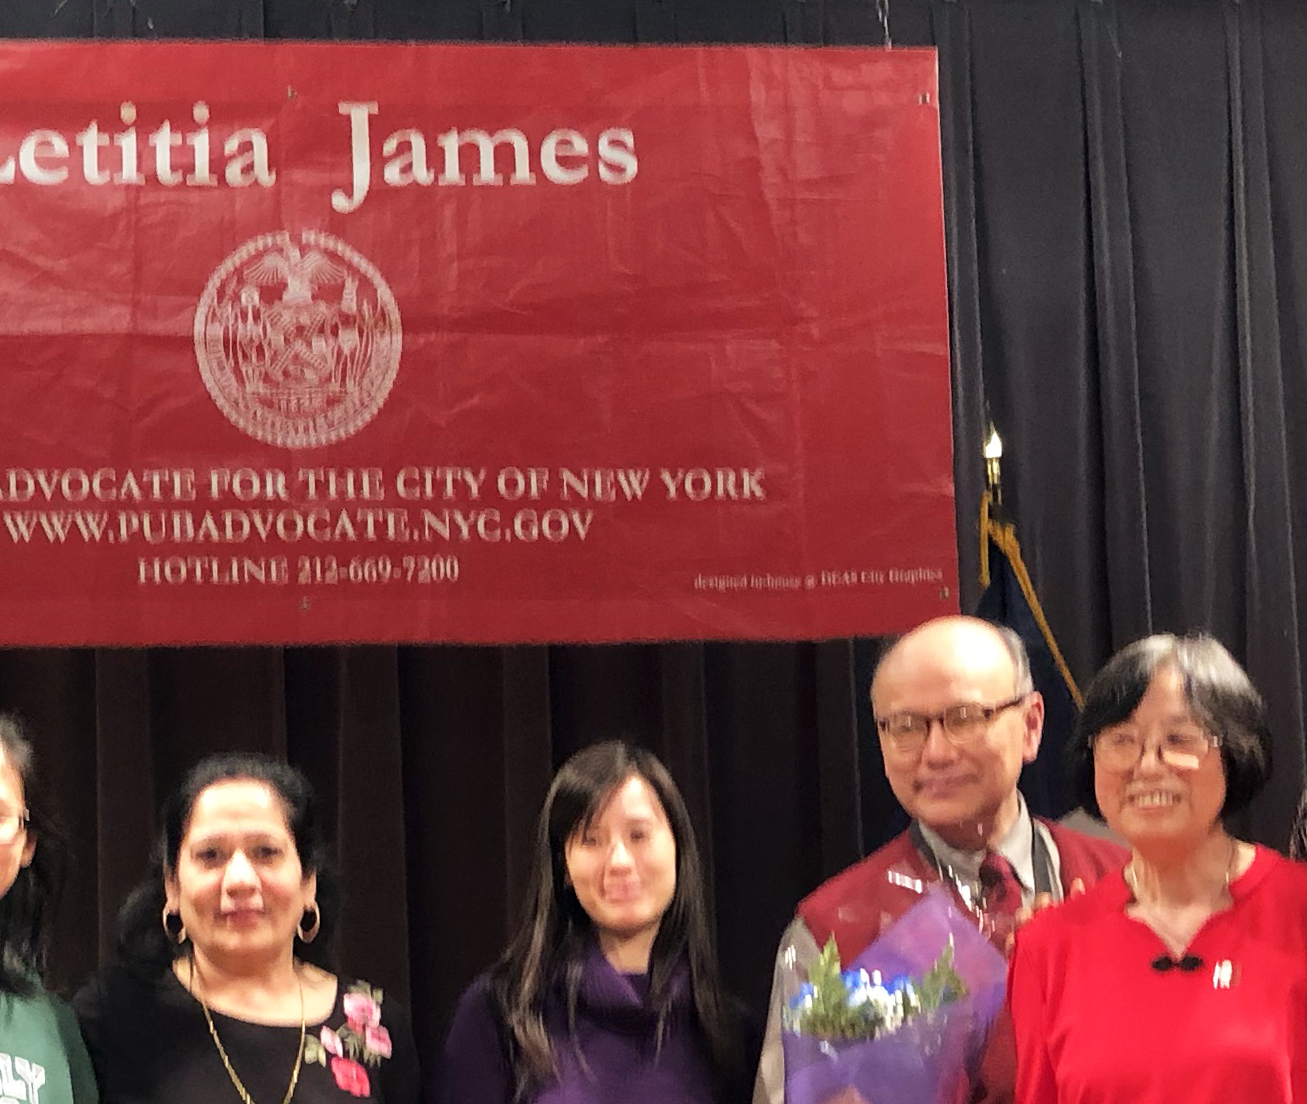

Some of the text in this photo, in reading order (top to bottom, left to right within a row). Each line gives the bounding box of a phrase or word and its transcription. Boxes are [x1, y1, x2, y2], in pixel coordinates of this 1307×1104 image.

[331, 102, 640, 214] James
[210, 467, 288, 501] FOR
[298, 467, 385, 501] THE
[396, 466, 485, 500] CITY
[496, 466, 549, 500] OF
[559, 466, 650, 501] NEW
[659, 466, 766, 501] YORK
[3, 507, 593, 543] WWW.PUBADVOCATE.NYC.GOV
[138, 554, 460, 585] HOTLINE 212-669-7200
